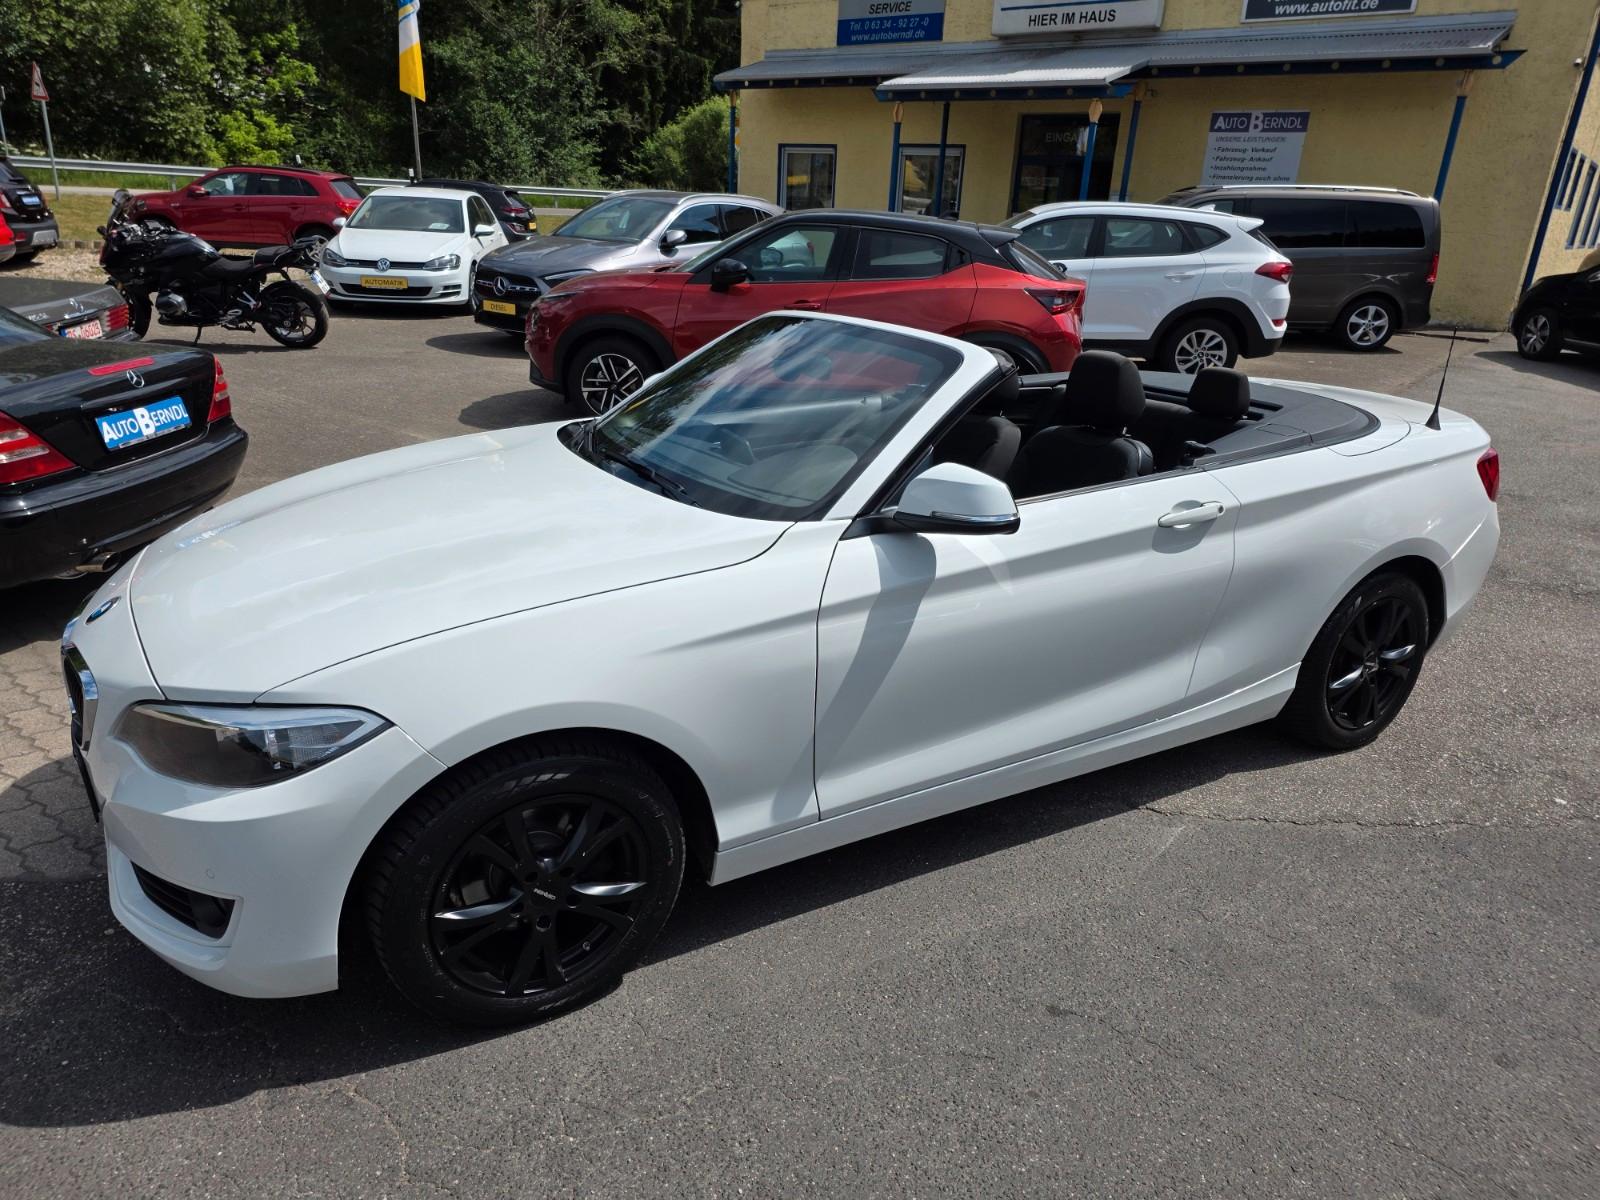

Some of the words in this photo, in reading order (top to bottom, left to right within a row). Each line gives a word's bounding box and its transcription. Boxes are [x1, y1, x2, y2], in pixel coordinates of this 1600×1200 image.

[869, 1, 912, 15] SERVICE
[1275, 0, 1379, 15] www.autofit.de
[864, 21, 870, 30] 0
[871, 20, 881, 29] 63
[882, 19, 892, 29] 34
[898, 18, 907, 28] 92
[909, 17, 920, 27] 27
[1028, 13, 1058, 27] HIER
[1061, 12, 1076, 25] IM
[1078, 9, 1117, 24] HAUS
[851, 29, 926, 41] www.autoberndl.de
[1211, 174, 1254, 182] Finanzierung
